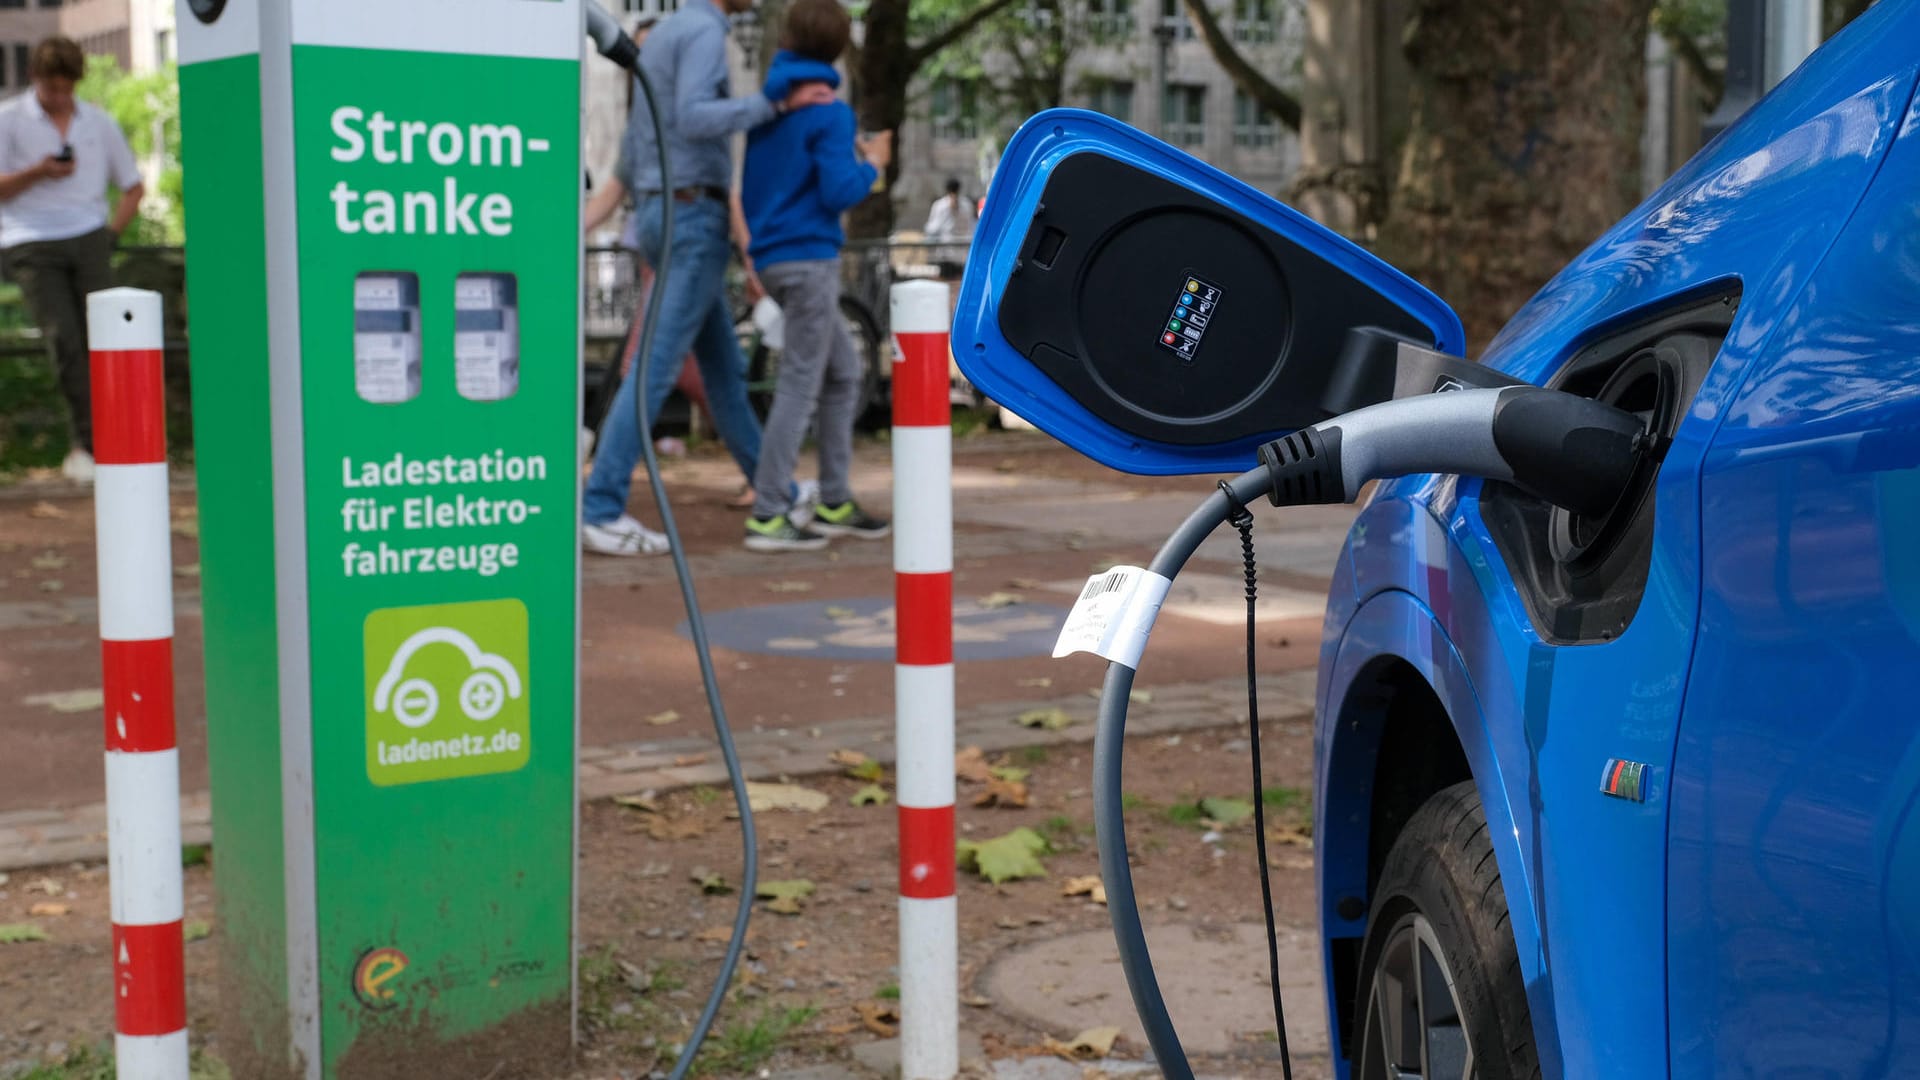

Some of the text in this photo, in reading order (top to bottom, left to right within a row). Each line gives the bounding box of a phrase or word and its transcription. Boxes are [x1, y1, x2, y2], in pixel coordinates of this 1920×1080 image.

[330, 106, 550, 167] Strom-
[329, 176, 513, 236] tanke
[341, 448, 546, 488] Ladestation
[341, 493, 541, 532] für Elektro-
[341, 541, 519, 576] fahrzeuge
[376, 727, 521, 767] ladenetz.de
